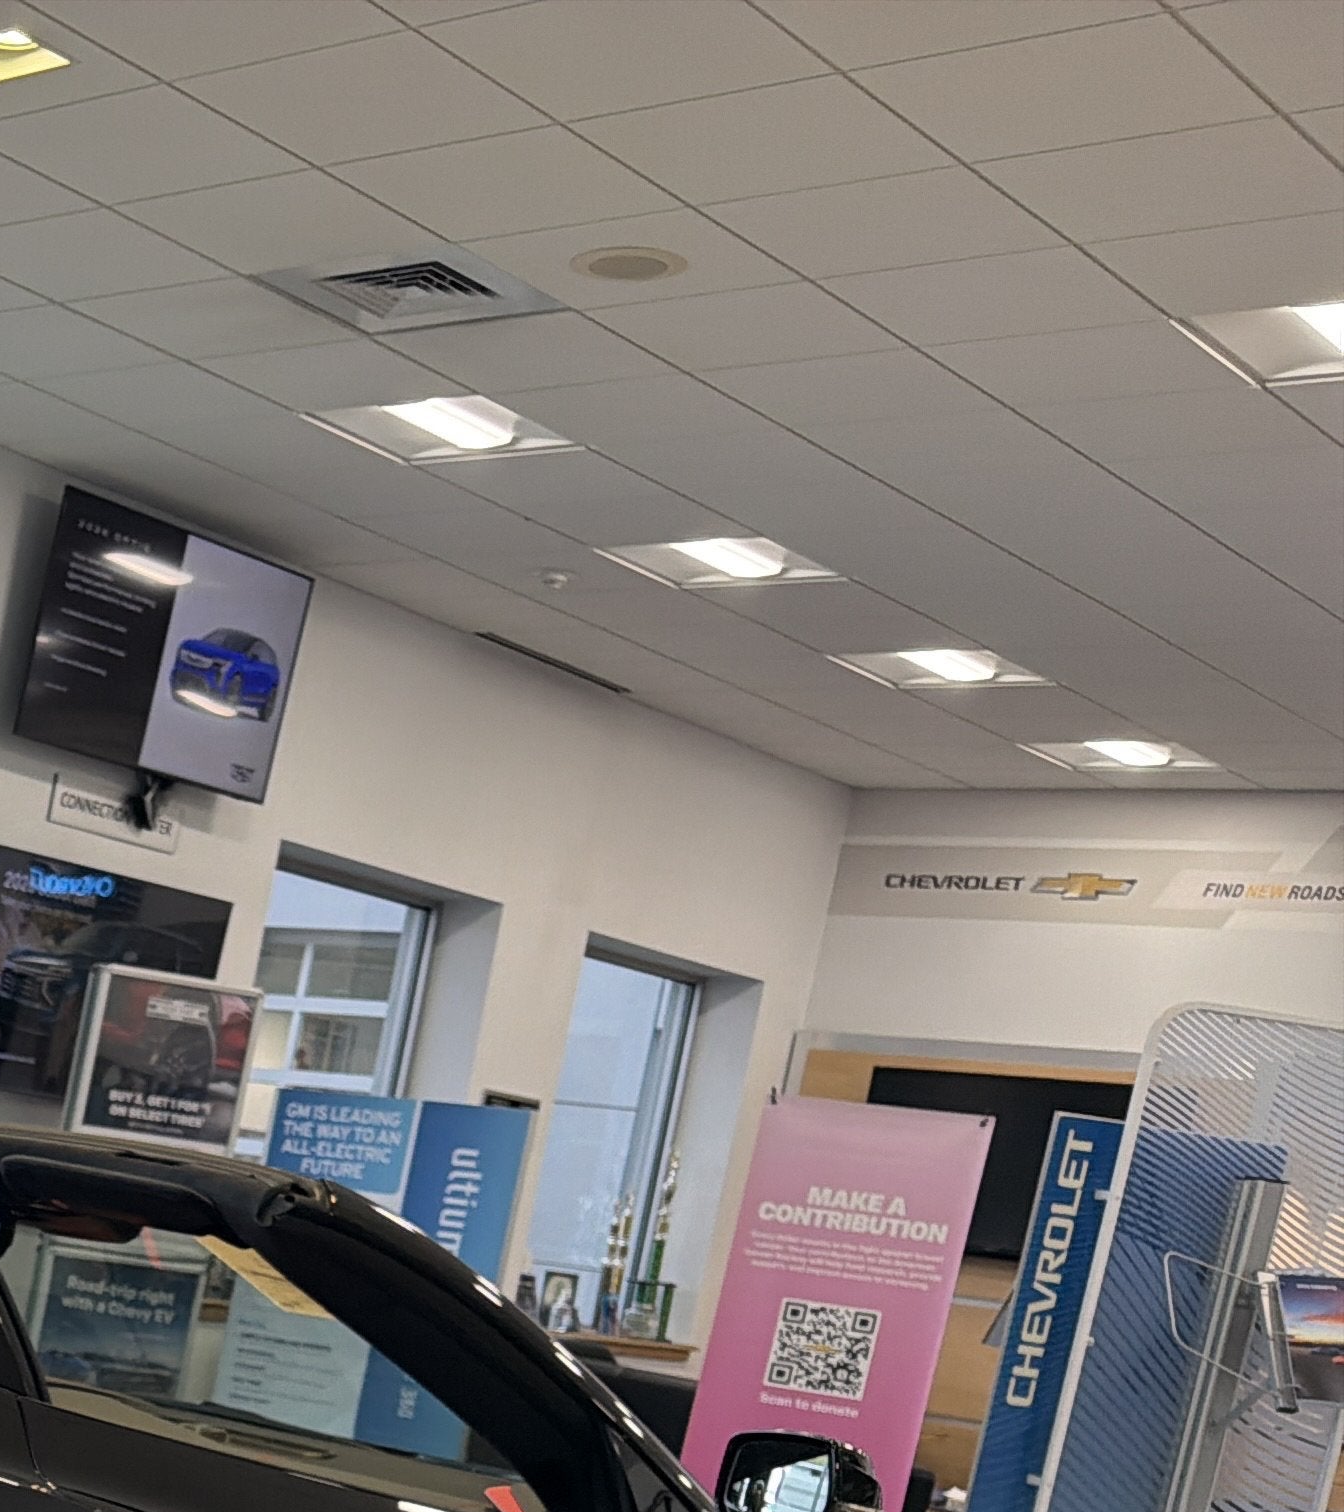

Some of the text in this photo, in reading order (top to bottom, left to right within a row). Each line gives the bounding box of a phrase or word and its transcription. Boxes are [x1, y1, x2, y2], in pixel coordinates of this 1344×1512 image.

[60, 791, 130, 824] CONNECTIO
[885, 873, 1025, 892] CHEVROLET
[1202, 882, 1344, 901] FIND NEW ROADS
[128, 1107, 169, 1124] SELECT
[285, 1102, 401, 1128] GM IS LEADING
[283, 1120, 402, 1146] THE WAY TO AN
[280, 1138, 392, 1164] ALL-ELECTRIC
[300, 1156, 366, 1180] FUTURE
[807, 1186, 907, 1216] MAKE A
[758, 1201, 949, 1244] CONTRIBUTION
[1006, 1128, 1093, 1408] CHEVROLET
